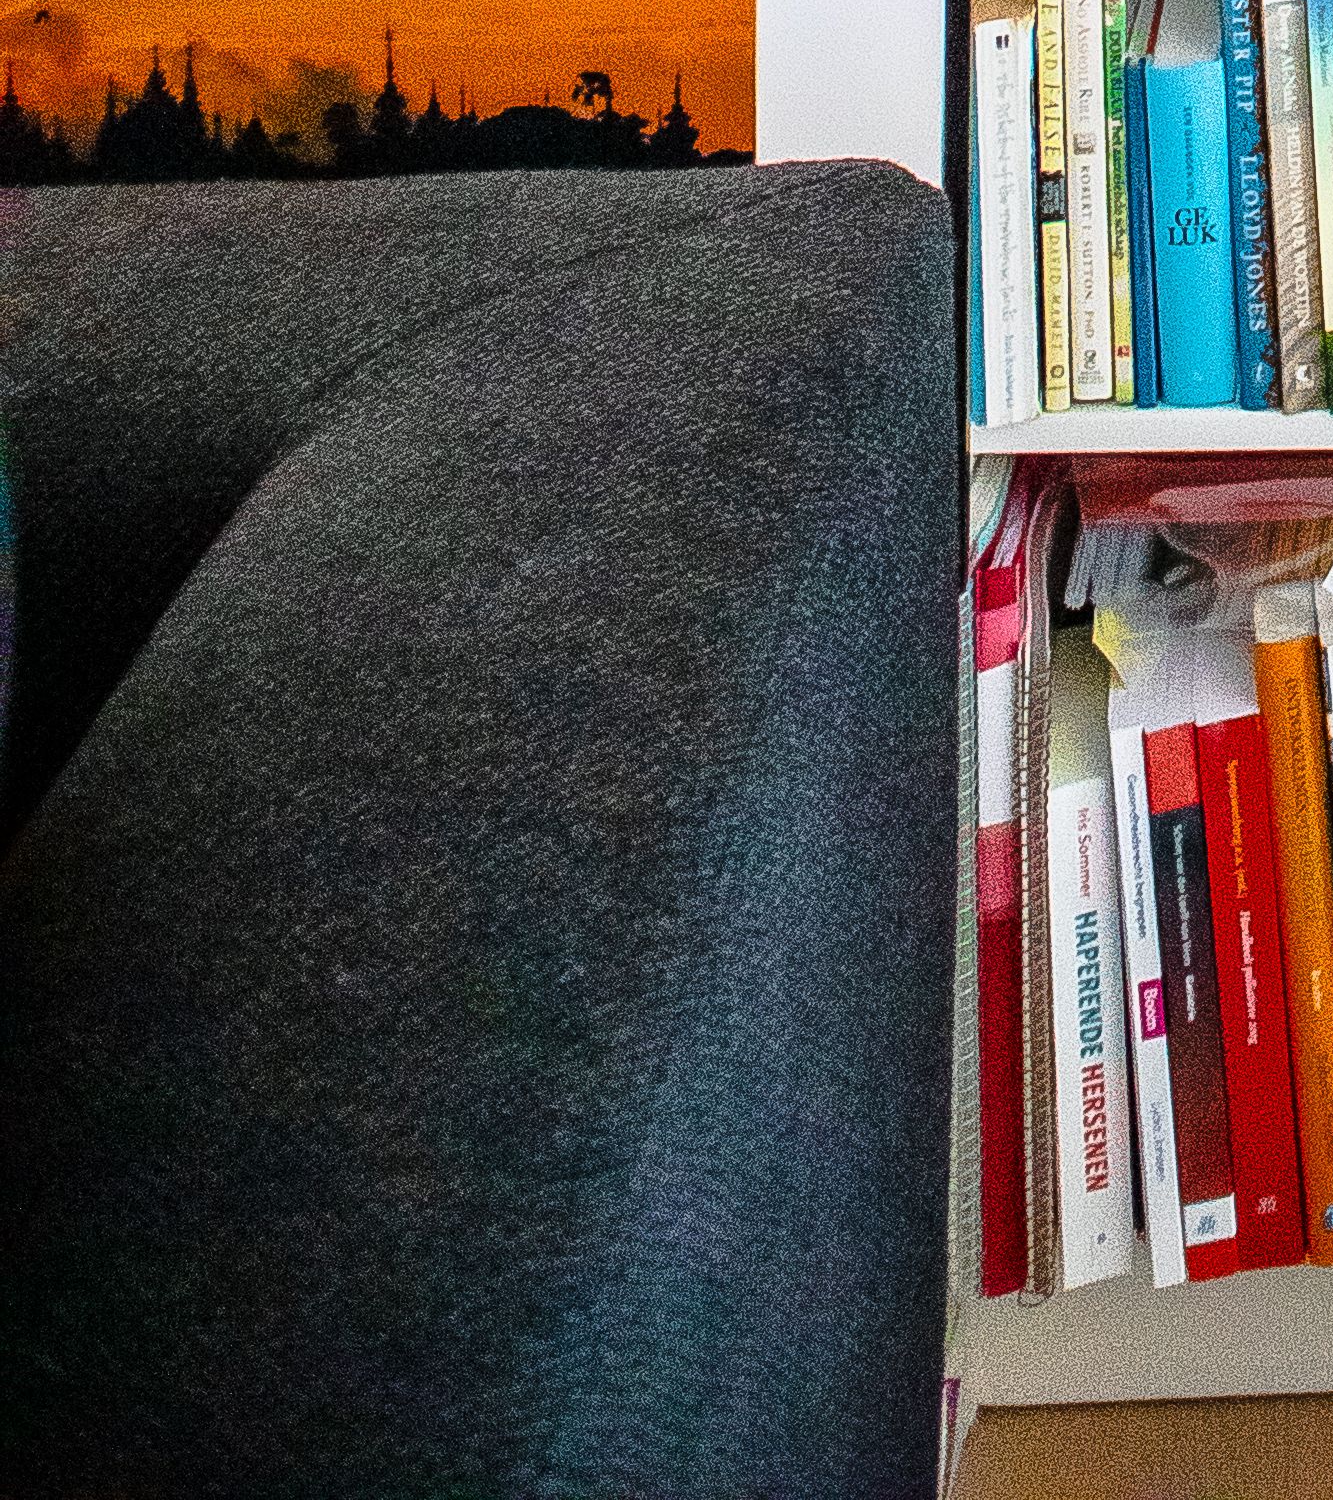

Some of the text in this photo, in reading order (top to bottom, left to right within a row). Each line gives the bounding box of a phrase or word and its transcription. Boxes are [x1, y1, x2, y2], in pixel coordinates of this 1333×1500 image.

[1236, 74, 1252, 113] PIP
[1239, 154, 1262, 240] LLOYD
[1241, 249, 1266, 332] JONES
[1074, 909, 1110, 1193] HAPERENDE HERSENEN
